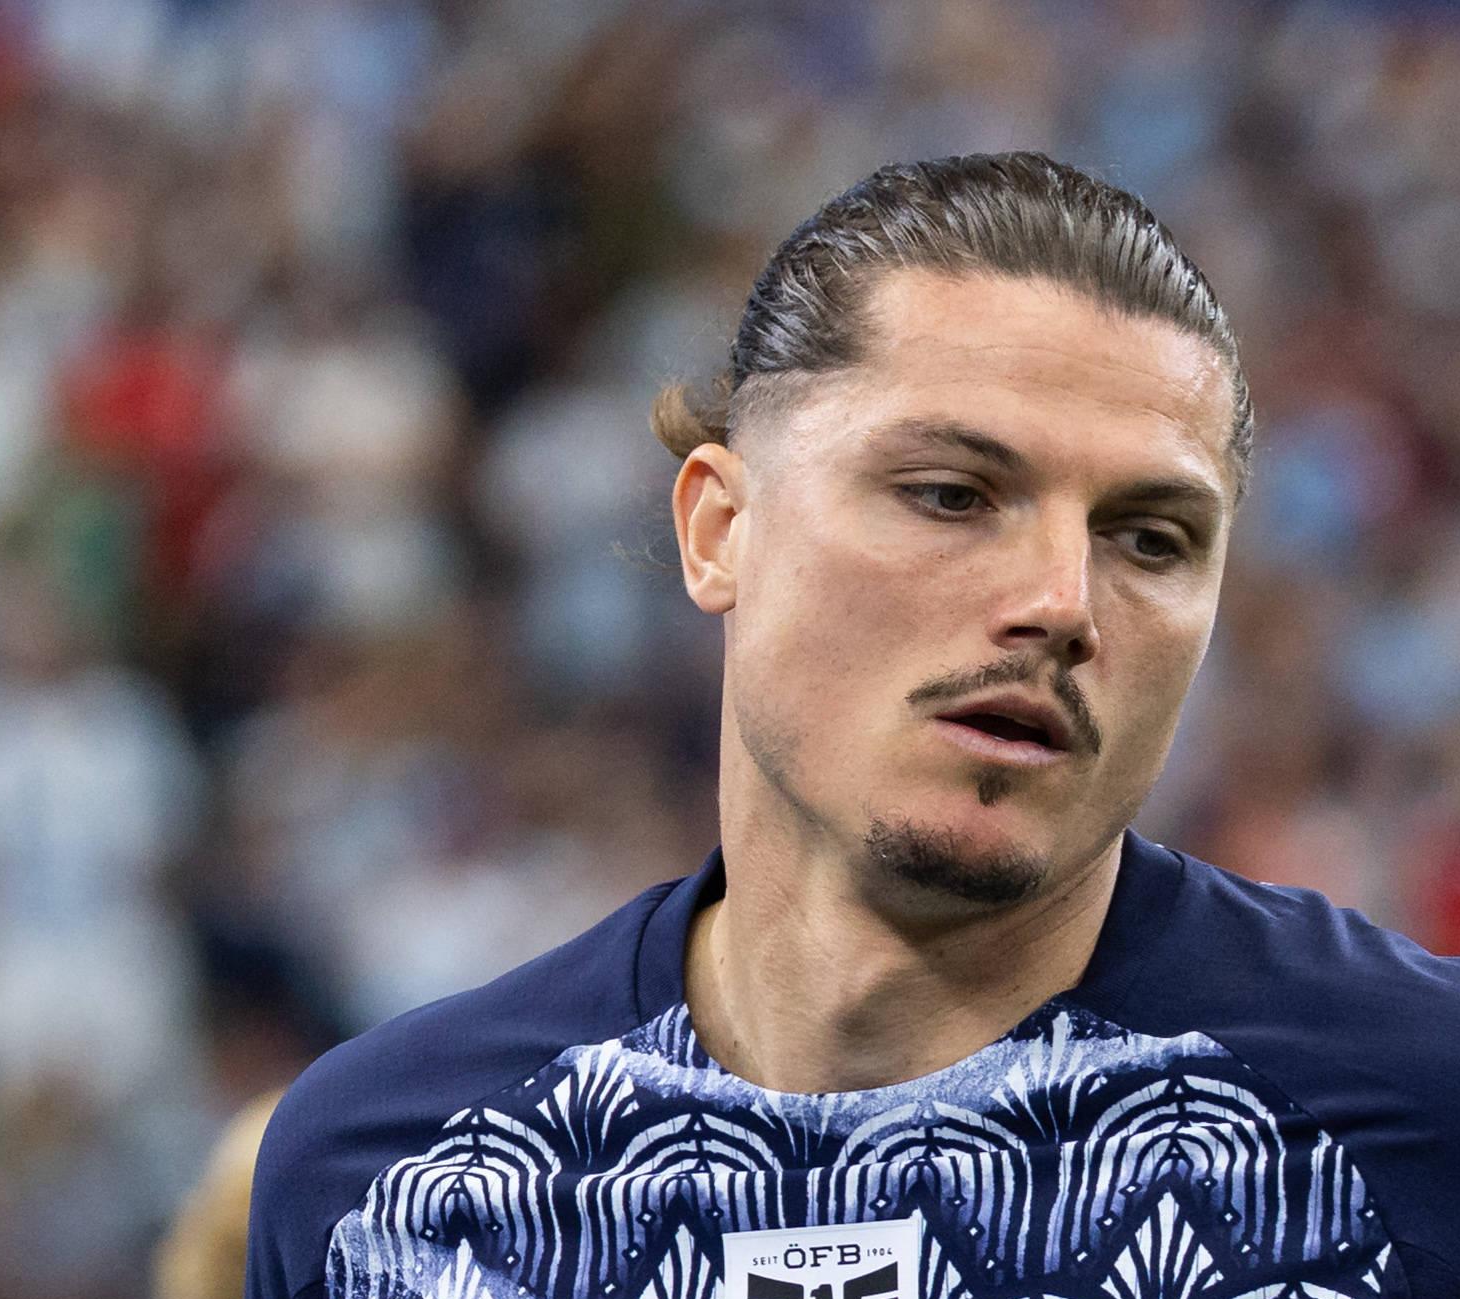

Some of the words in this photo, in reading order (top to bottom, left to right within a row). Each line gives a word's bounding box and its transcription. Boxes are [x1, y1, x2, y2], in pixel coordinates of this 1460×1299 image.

[752, 1256, 778, 1266] SEIT
[783, 1243, 861, 1269] ÖFB
[867, 1248, 893, 1257] 1904
